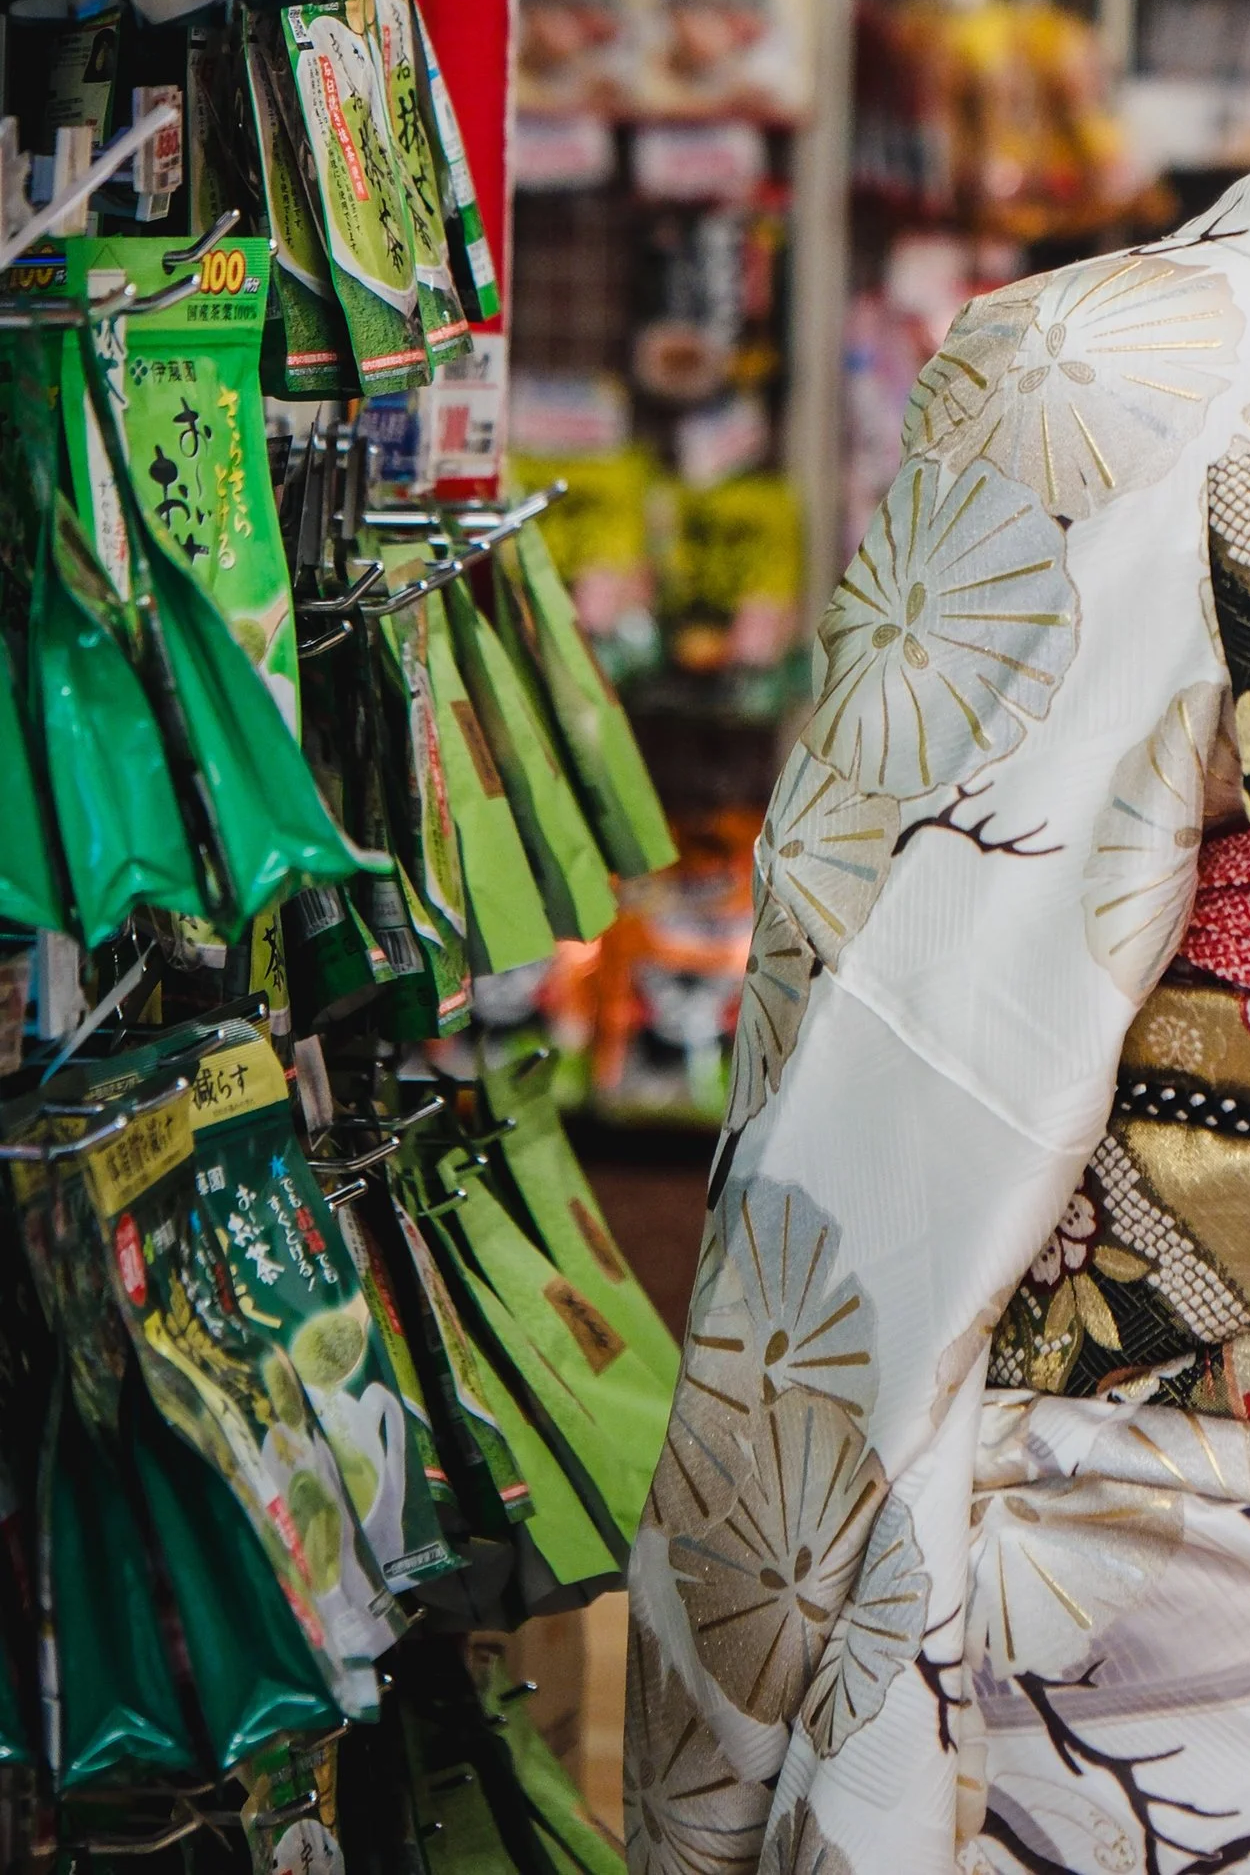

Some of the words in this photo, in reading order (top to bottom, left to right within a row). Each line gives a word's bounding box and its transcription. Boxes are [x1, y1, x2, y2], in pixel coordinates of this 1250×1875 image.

[187, 302, 258, 322] 国産茶葉100%
[150, 359, 197, 383] 伊藤園
[217, 385, 253, 539] さらさら
[214, 463, 237, 571] とける
[193, 1064, 249, 1112] 減らす
